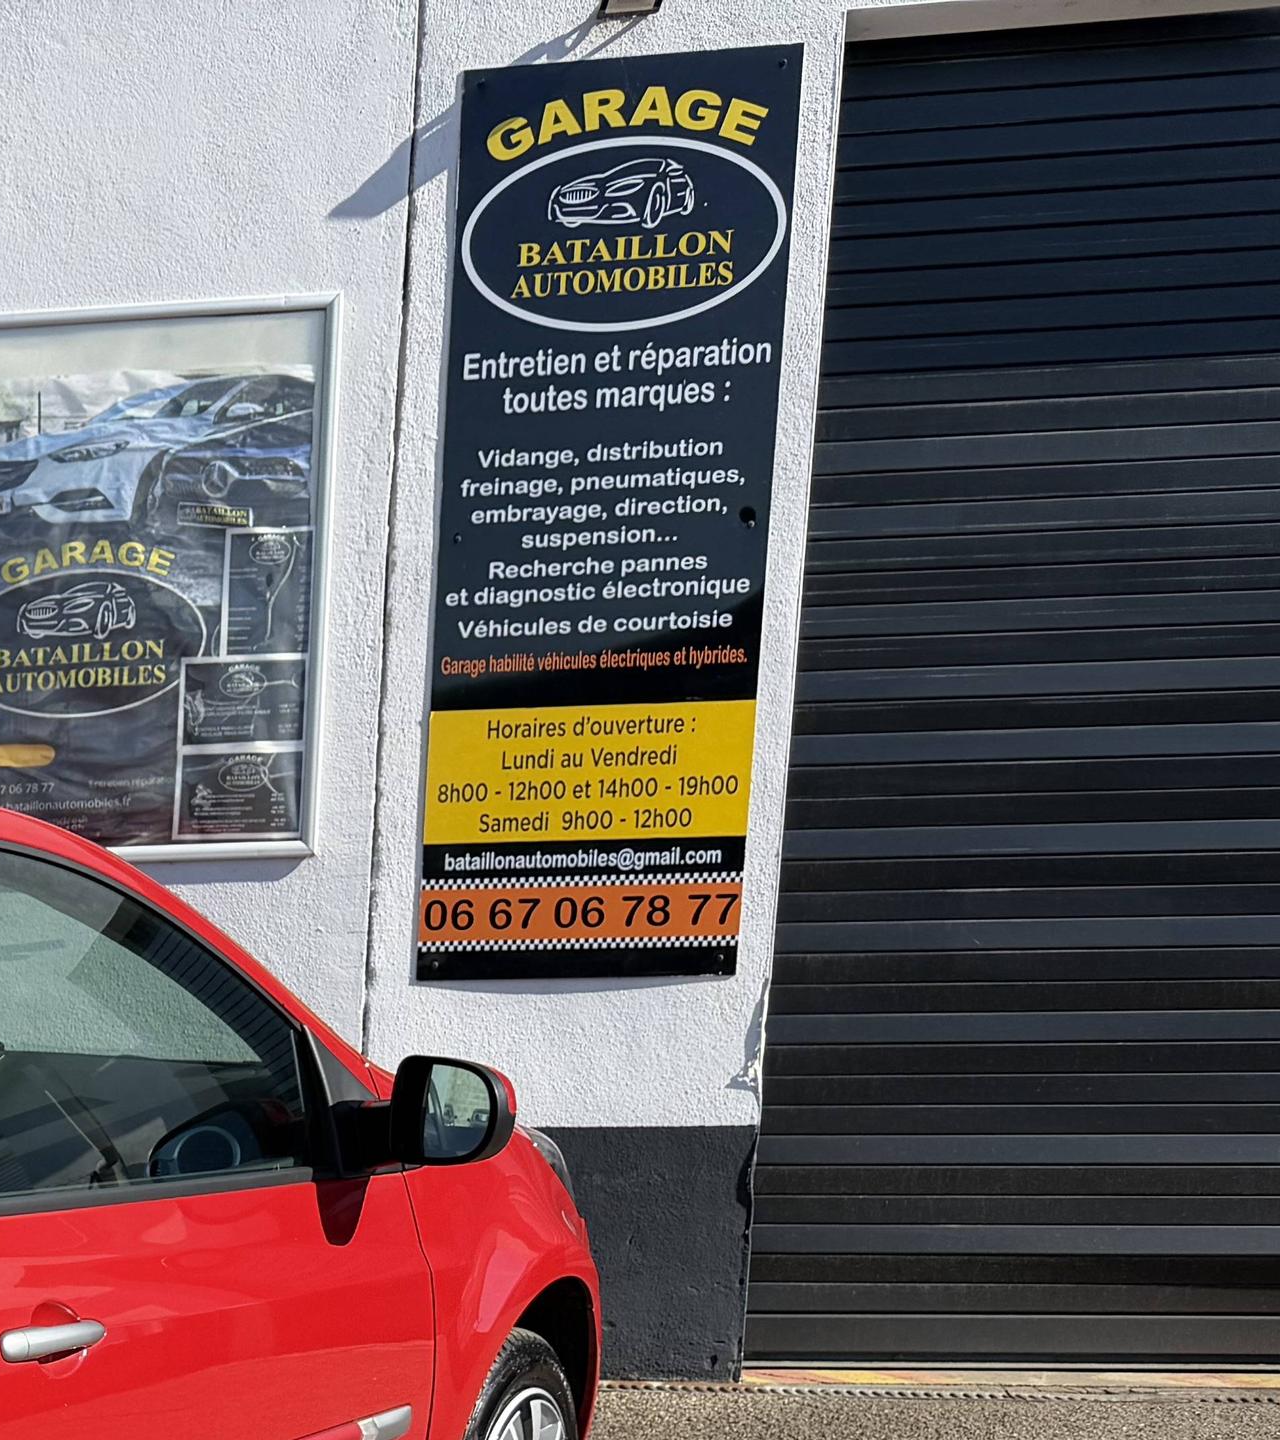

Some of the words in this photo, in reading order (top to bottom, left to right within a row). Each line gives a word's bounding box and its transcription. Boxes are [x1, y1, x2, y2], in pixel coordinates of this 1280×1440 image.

[486, 86, 769, 161] GARAGE
[517, 229, 734, 267] BATAILLON
[511, 261, 734, 299] AUTOMOBILES
[463, 350, 586, 381] Entretien
[595, 346, 620, 371] et
[628, 338, 772, 375] réparation
[503, 386, 588, 415] toutes
[596, 380, 715, 411] marques
[477, 449, 580, 470] Vidange,
[587, 438, 723, 463] distribution
[460, 478, 564, 498] freinage,
[570, 467, 745, 495] pneumatiques,
[471, 504, 607, 525] embrayage,
[614, 496, 728, 517] direction,
[521, 526, 678, 551] suspension...
[0, 540, 176, 584] GARAGE
[489, 557, 614, 579] Recherche
[621, 555, 708, 577] pannes
[445, 588, 468, 607] et
[474, 583, 596, 608] diagnostic
[602, 575, 750, 601] électronique
[458, 616, 571, 639] Véhicules
[577, 615, 607, 634] de
[613, 609, 733, 632] courtoisie
[441, 656, 486, 678] Garage
[489, 654, 535, 673] habilité
[538, 651, 597, 671] véhicules
[599, 649, 670, 671] électriques
[674, 650, 687, 666] et
[689, 645, 748, 669] hybrides.
[487, 719, 566, 740] Horaires
[573, 715, 685, 738] d'ouverture
[501, 749, 555, 770] Lundi
[560, 752, 584, 768] au
[591, 745, 677, 766] Vendredi
[9, 783, 23, 794] 06
[25, 783, 39, 793] 78
[41, 782, 55, 793] 77
[437, 783, 488, 803] 8h00
[508, 781, 566, 801] 12h00
[572, 783, 591, 799] et
[598, 777, 659, 798] 14h00
[678, 775, 739, 796] 19h00
[479, 812, 549, 833] Samedi
[562, 811, 613, 830] 9h00
[633, 808, 692, 829] 12h00
[444, 848, 722, 872] bataillonautomobiles@gmail.com
[424, 899, 475, 931] 06
[489, 898, 540, 930] 67
[553, 896, 605, 928] 06
[621, 895, 671, 927] 78
[688, 893, 739, 926] 77
